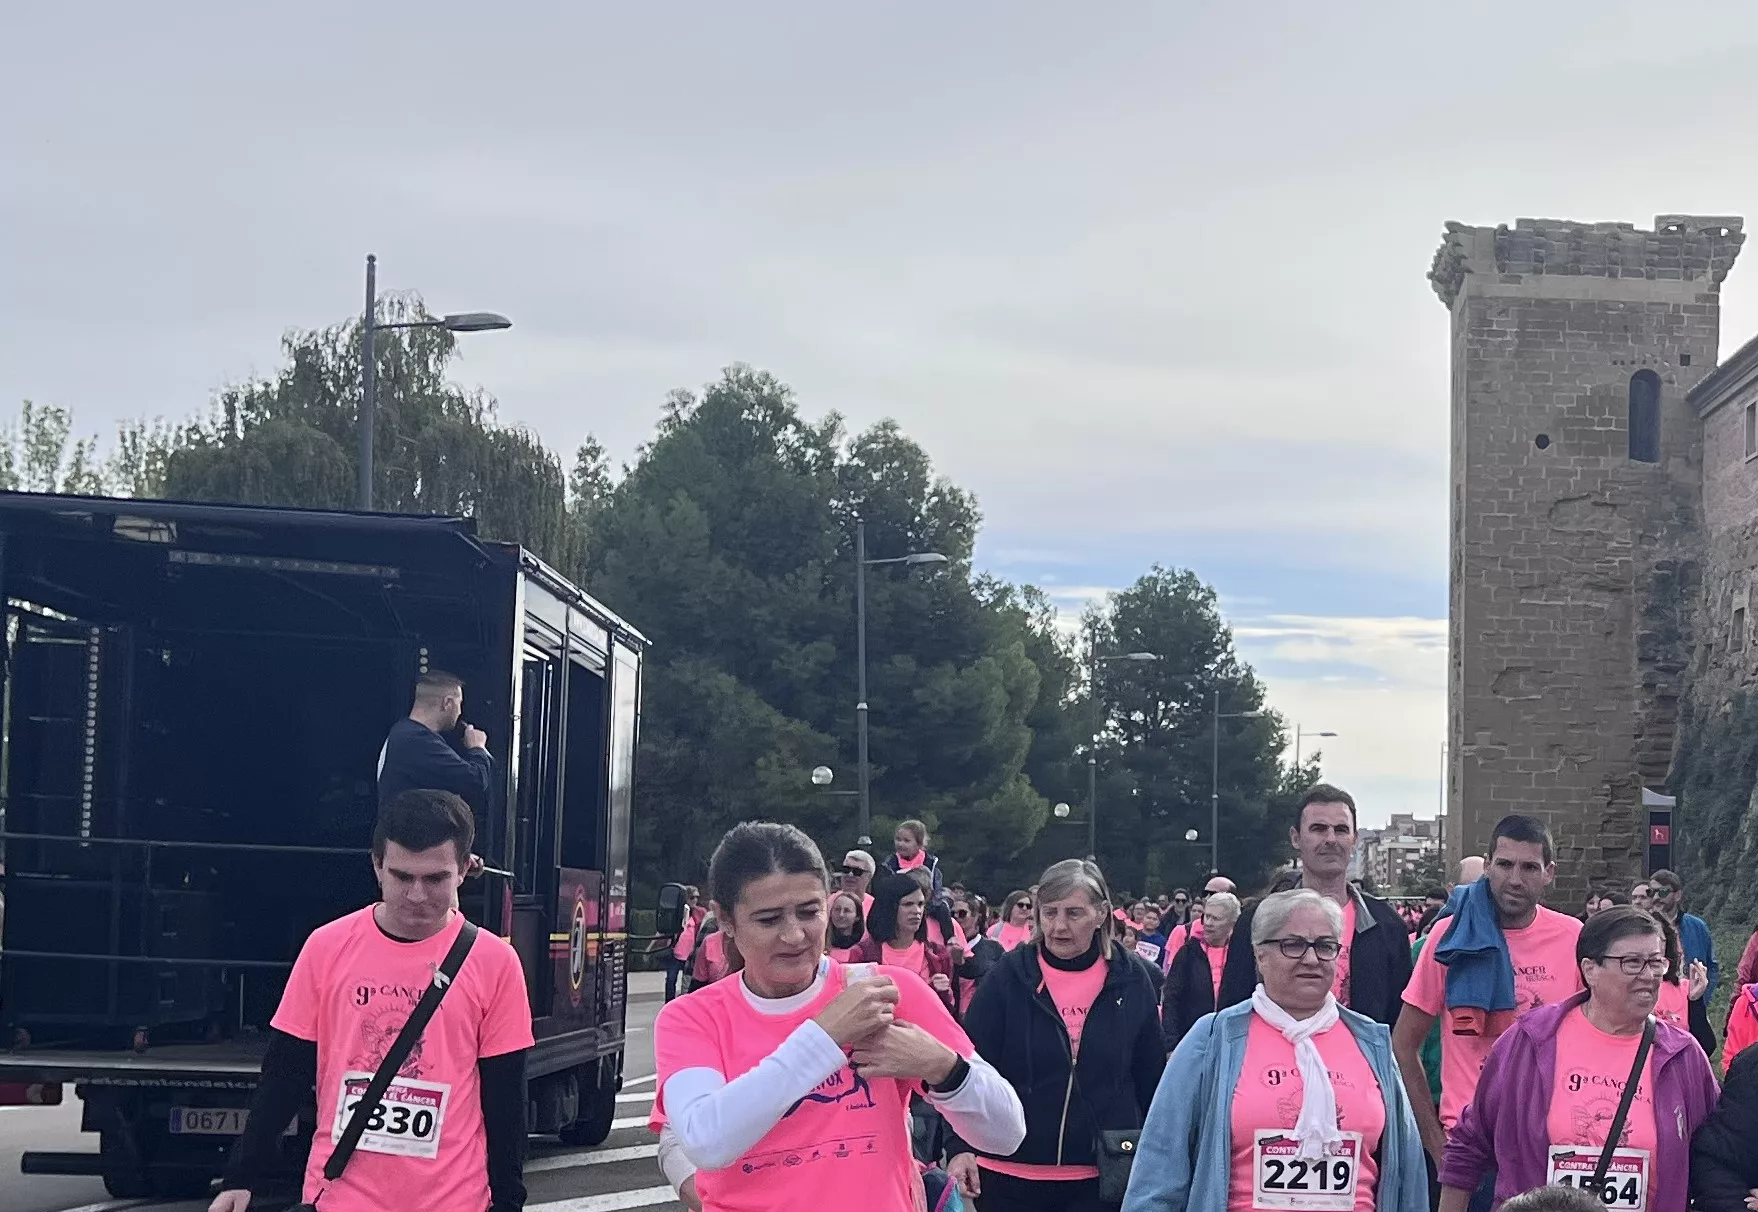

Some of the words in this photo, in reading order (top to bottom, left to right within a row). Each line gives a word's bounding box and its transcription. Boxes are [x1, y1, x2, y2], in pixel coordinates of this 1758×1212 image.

[186, 1111, 239, 1130] 0671
[347, 1101, 433, 1138] 830
[1264, 1159, 1350, 1191] 2219
